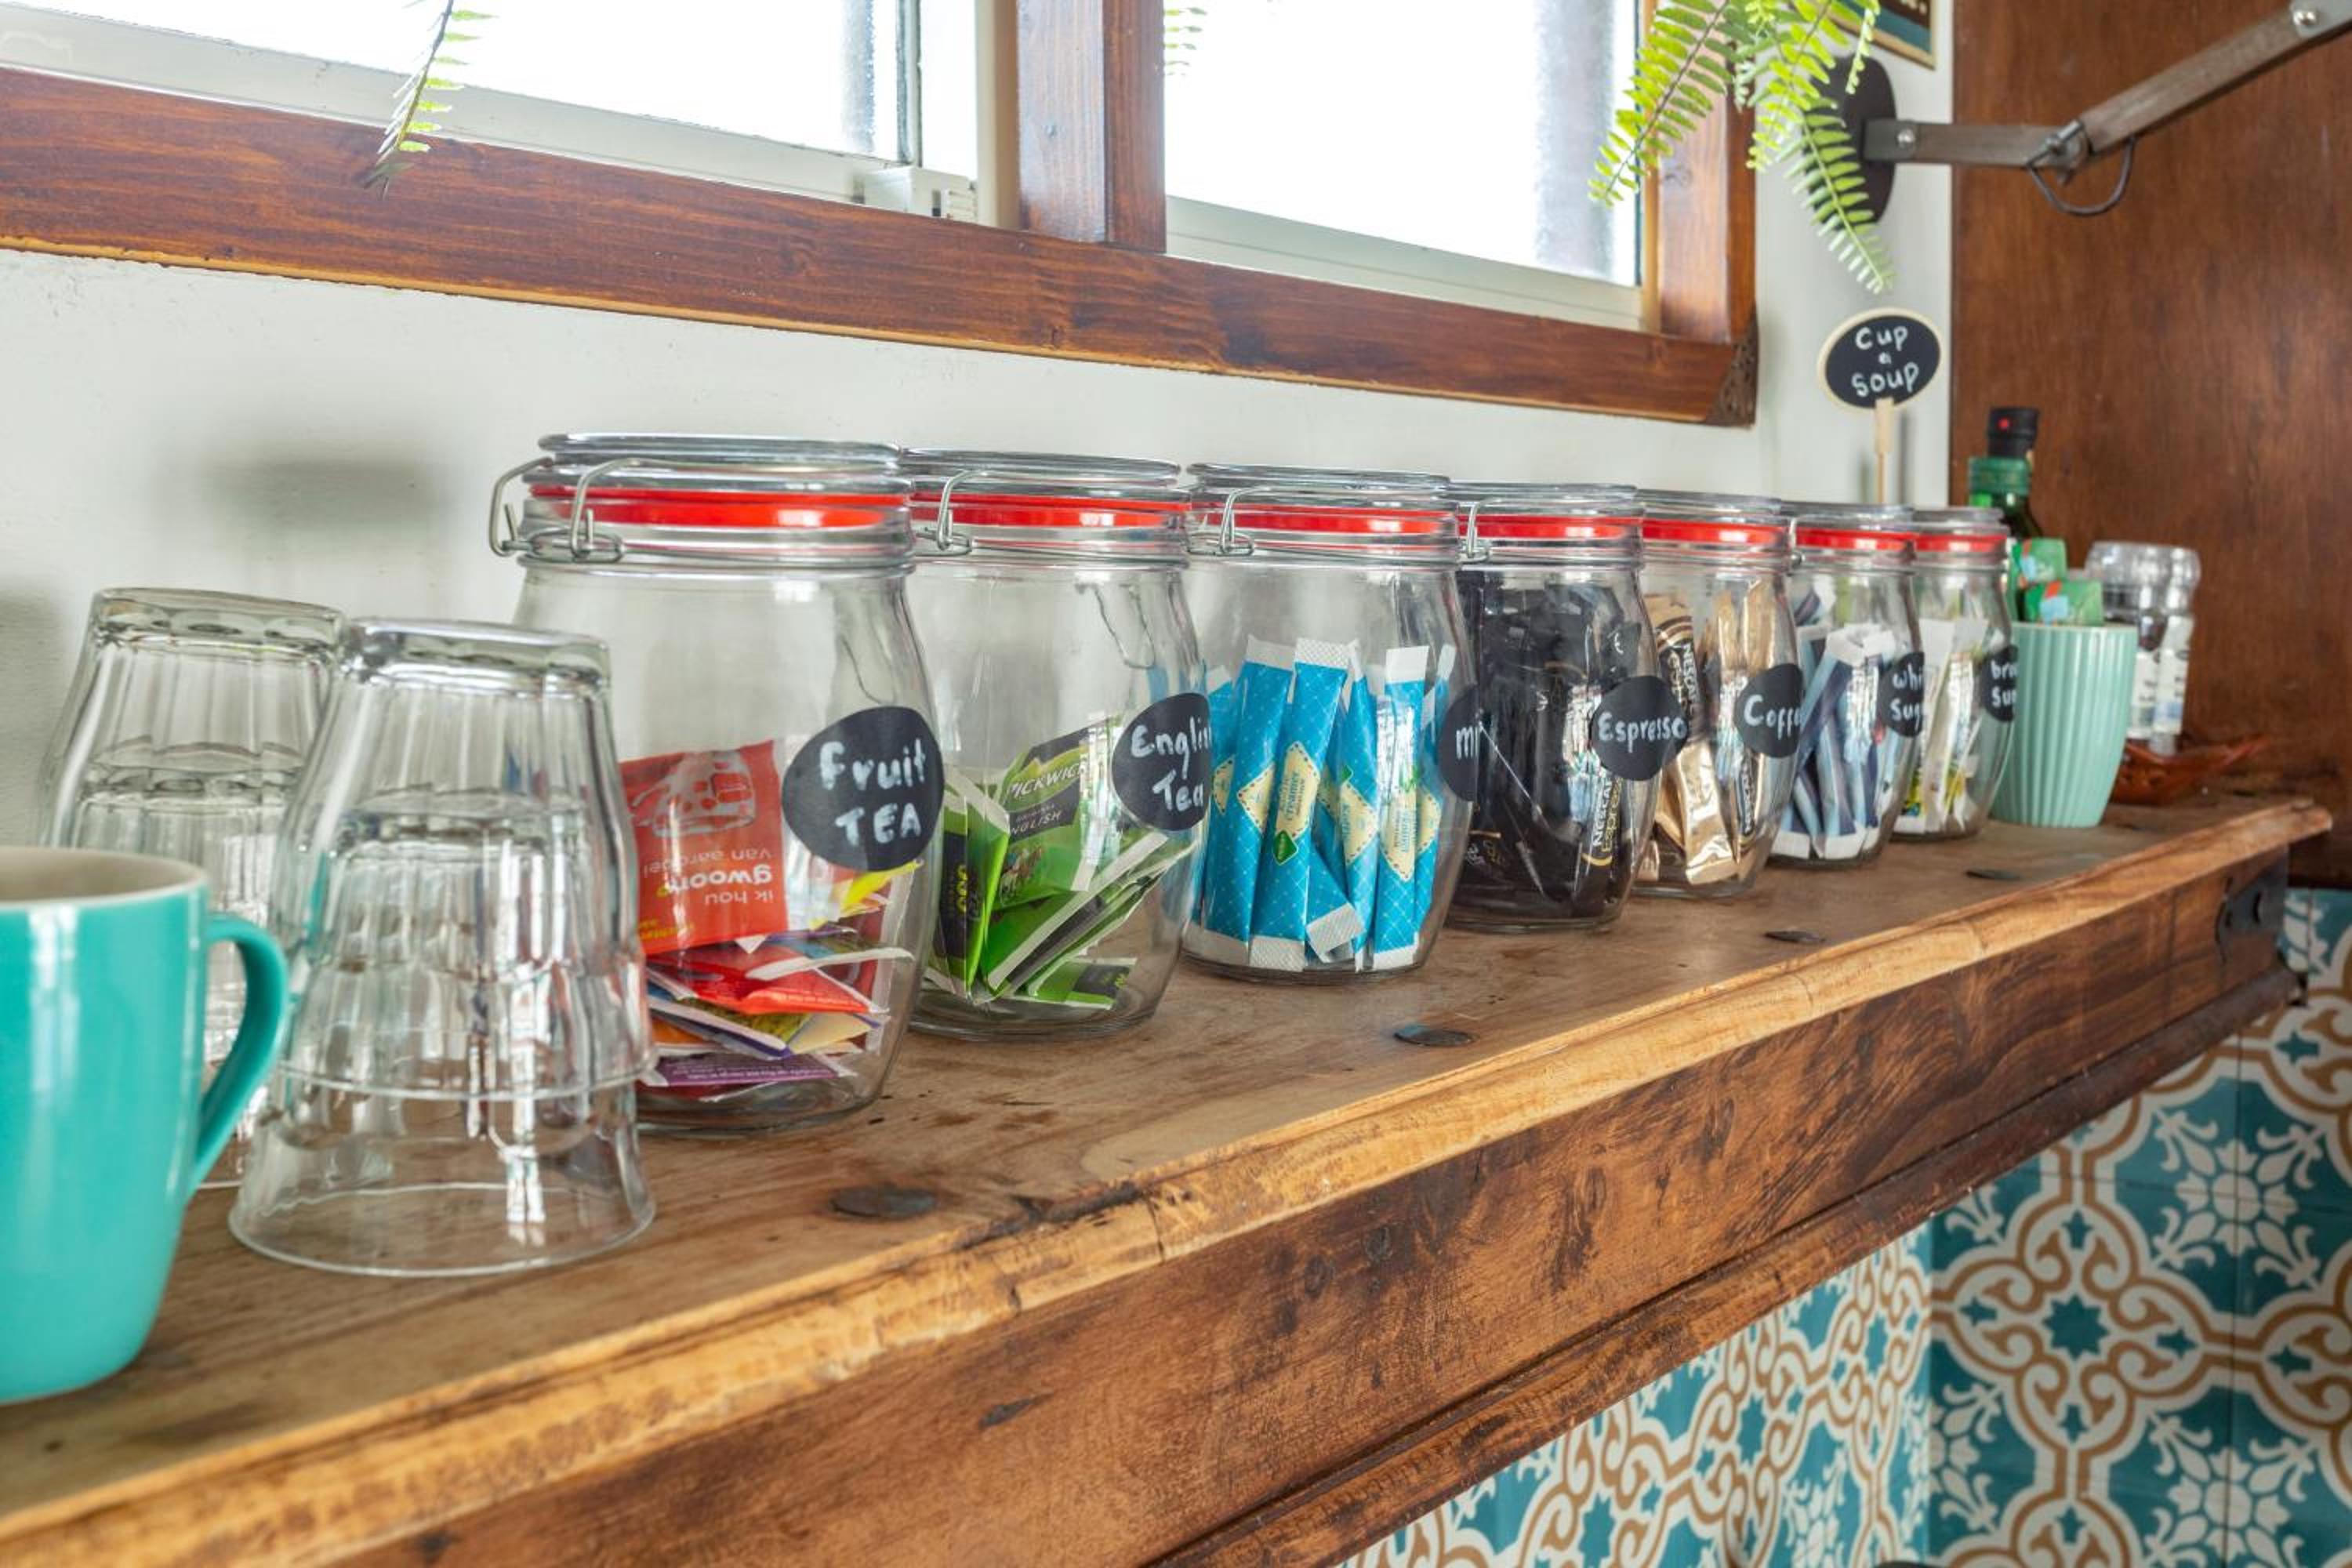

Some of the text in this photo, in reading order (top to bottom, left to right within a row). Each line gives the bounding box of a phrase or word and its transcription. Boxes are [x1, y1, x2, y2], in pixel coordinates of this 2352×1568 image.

[820, 738, 926, 791] Fruit
[1152, 769, 1203, 811] Tea
[834, 802, 921, 847] TEA
[705, 889, 748, 905] hou
